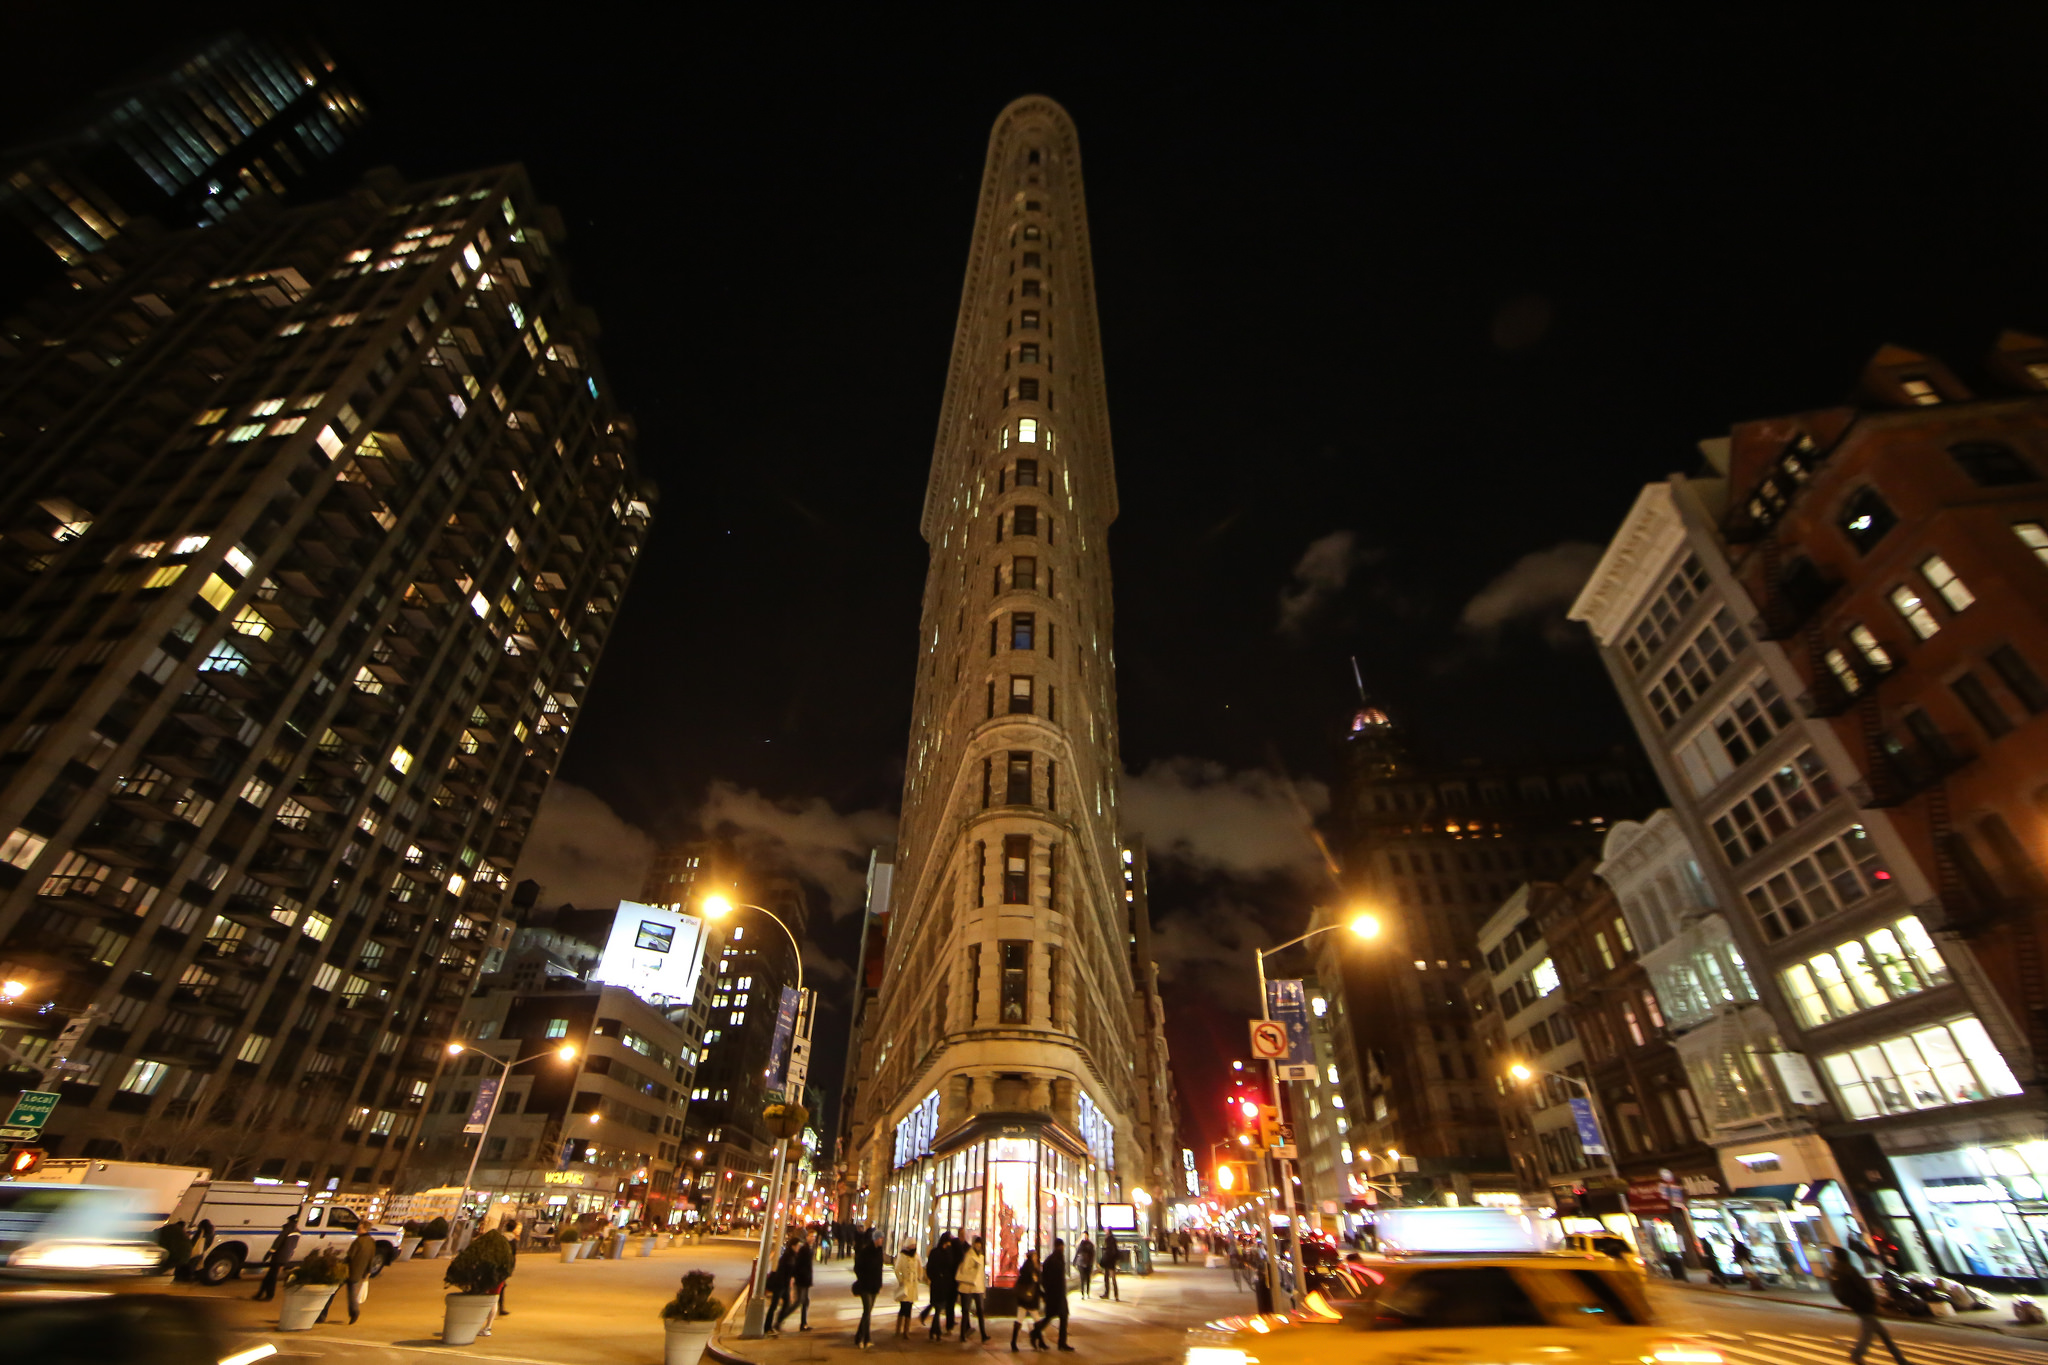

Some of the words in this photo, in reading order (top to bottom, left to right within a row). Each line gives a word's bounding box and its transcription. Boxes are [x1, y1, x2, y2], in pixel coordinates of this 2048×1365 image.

[24, 1094, 54, 1104] Local
[17, 1103, 51, 1113] Streets
[1002, 1126, 1019, 1134] Sprint
